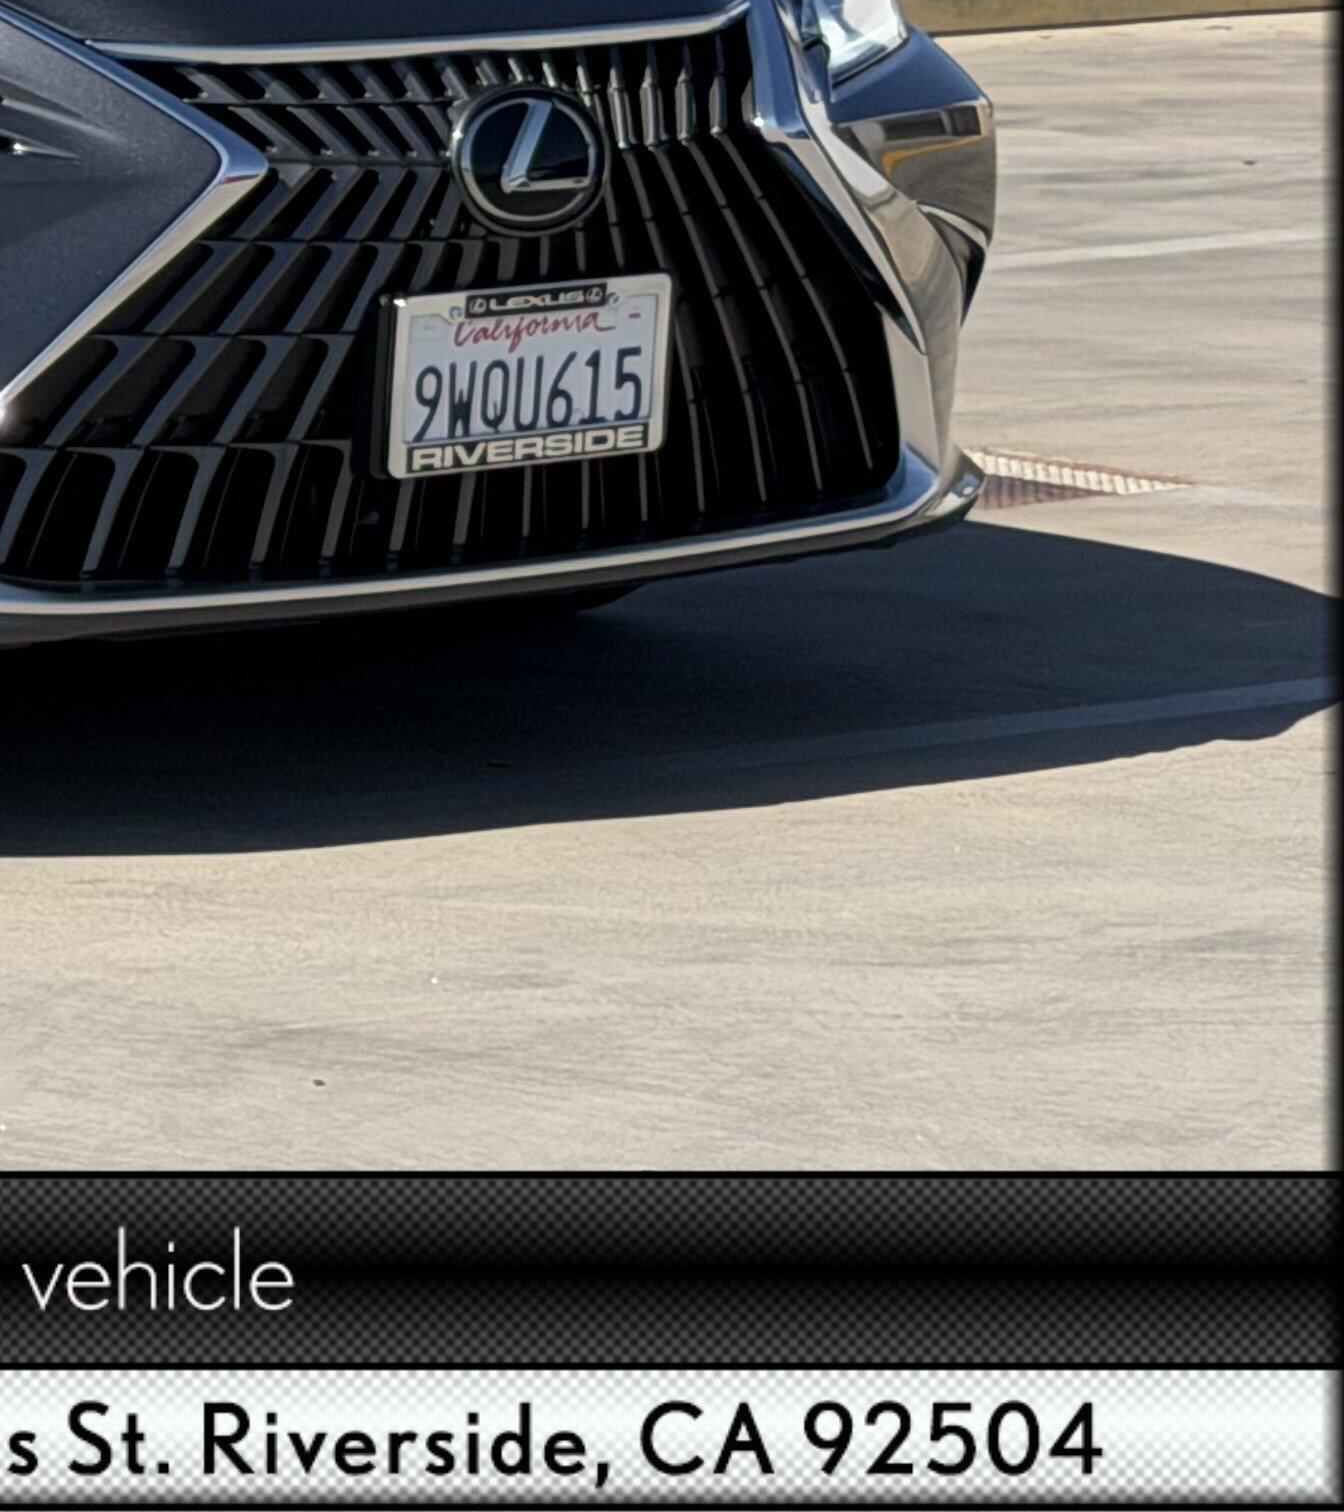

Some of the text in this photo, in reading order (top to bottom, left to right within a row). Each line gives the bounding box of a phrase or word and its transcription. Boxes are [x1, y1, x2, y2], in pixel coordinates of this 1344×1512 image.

[489, 290, 586, 310] LEXUS
[454, 311, 617, 352] California
[413, 346, 643, 443] 9WQU615
[413, 424, 645, 471] RIVERSIDE
